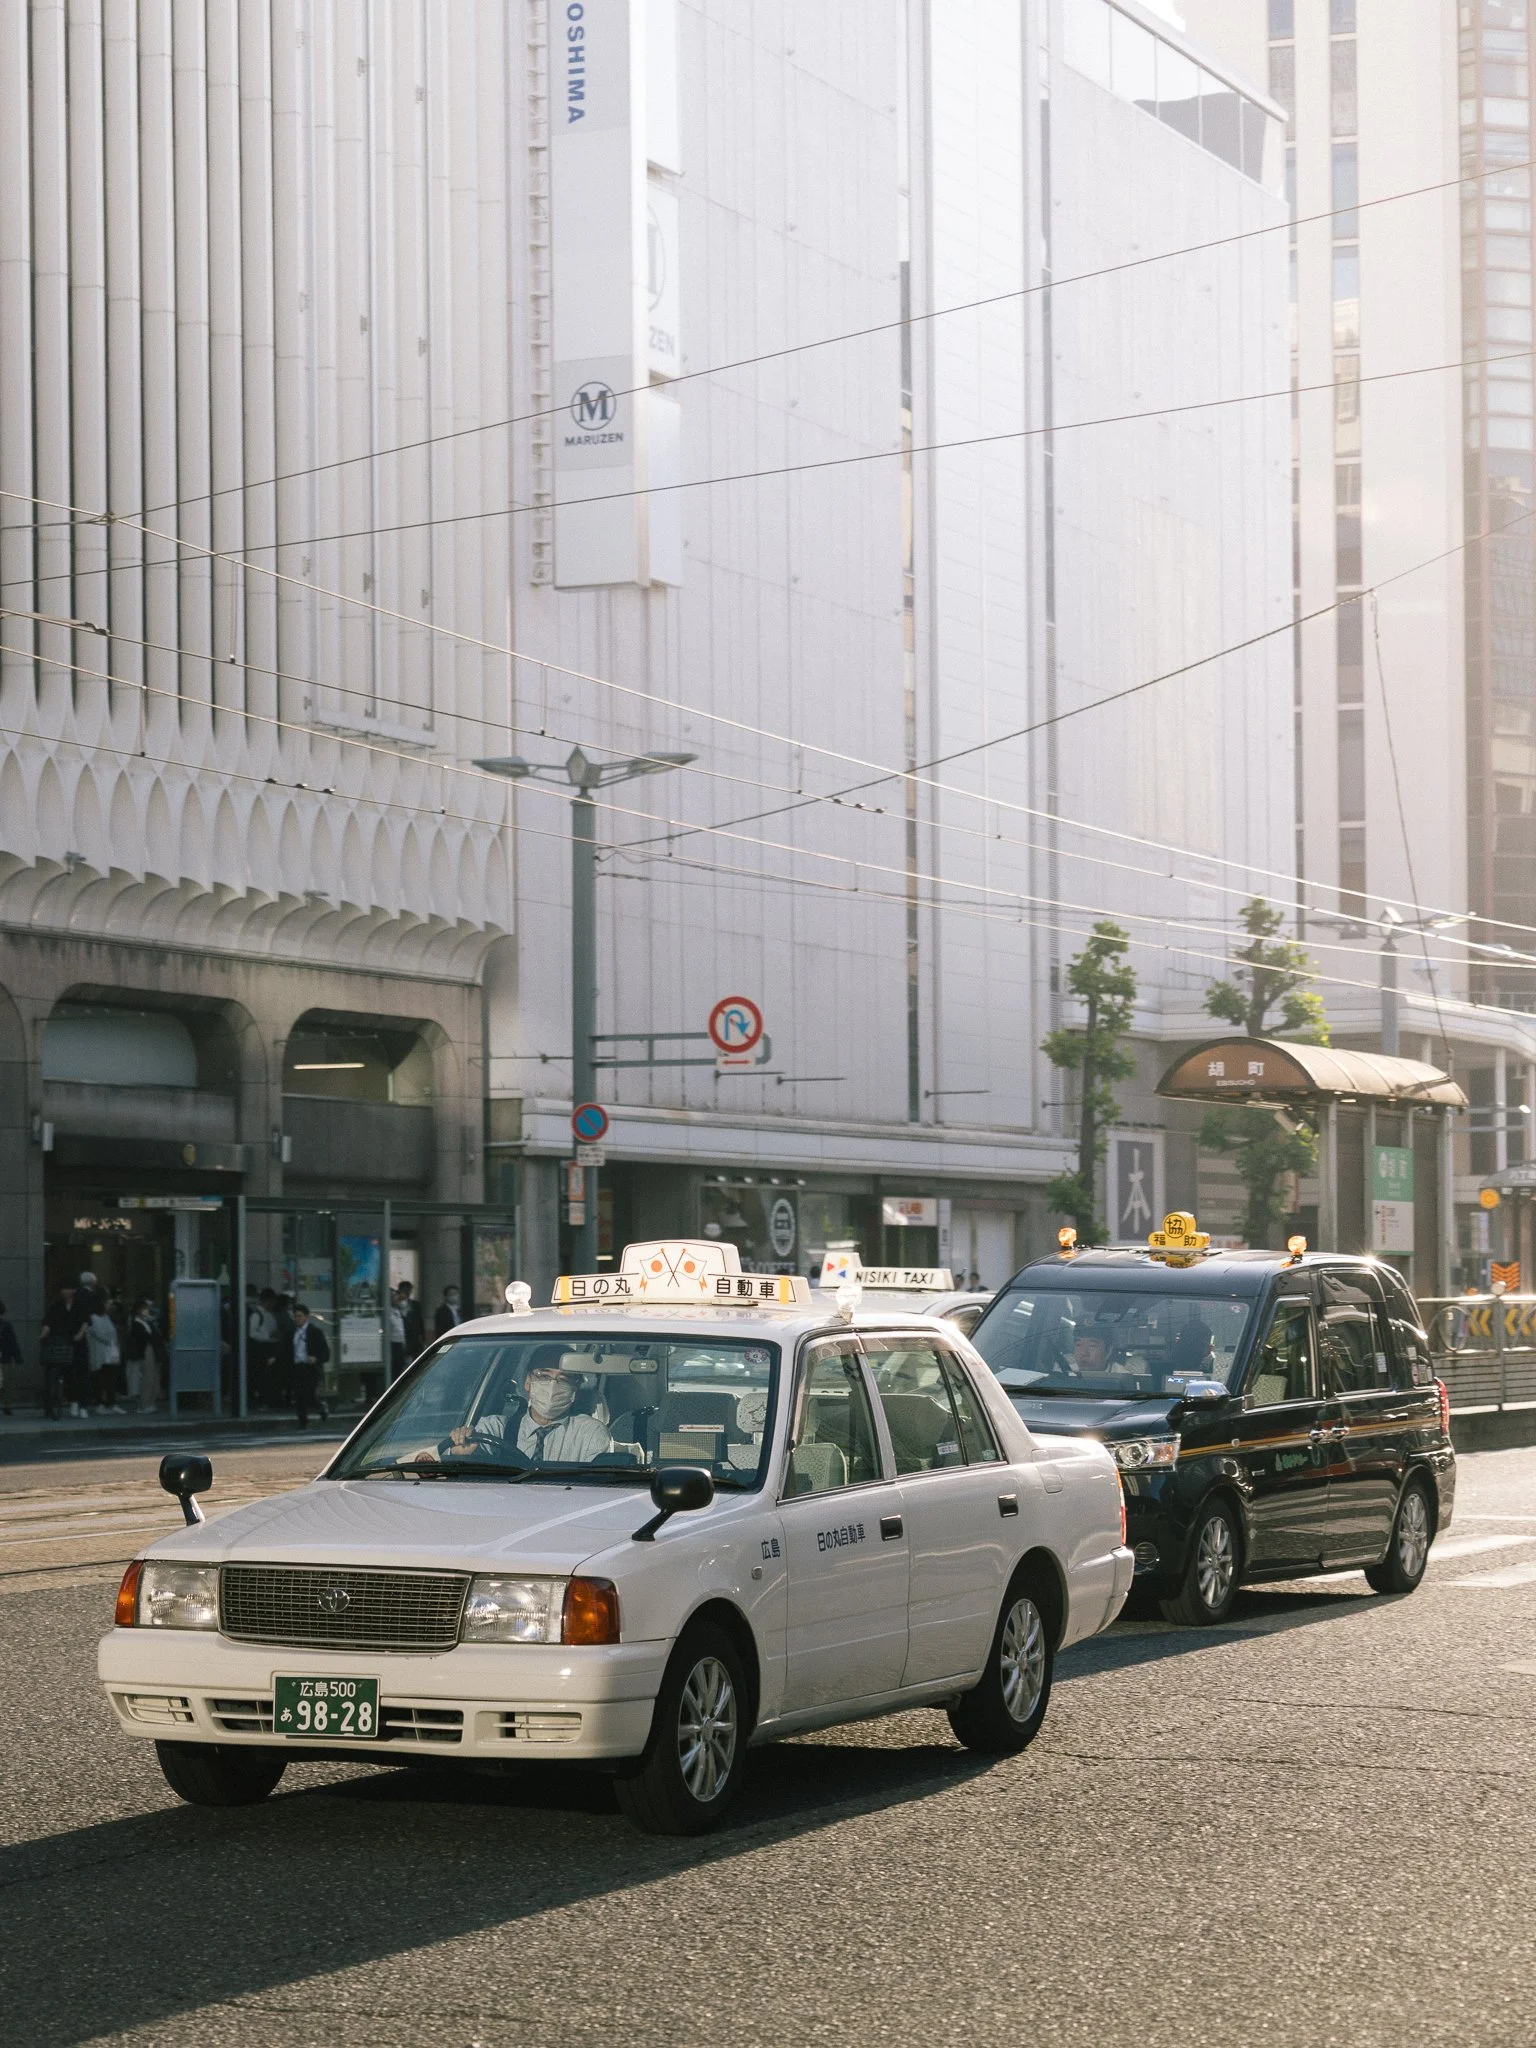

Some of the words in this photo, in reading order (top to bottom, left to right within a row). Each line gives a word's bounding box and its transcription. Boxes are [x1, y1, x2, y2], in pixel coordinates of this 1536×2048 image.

[564, 433, 624, 447] MARUZEN
[1166, 1218, 1184, 1235] 協
[571, 1276, 631, 1297] 日の丸
[716, 1278, 775, 1298] 自動車
[854, 1270, 897, 1283] NISIKI
[904, 1271, 934, 1284] TAXI
[761, 1537, 781, 1560] 広島
[817, 1523, 866, 1552] 日の丸自動車
[280, 1707, 293, 1723] あ
[296, 1700, 372, 1732] 98-28
